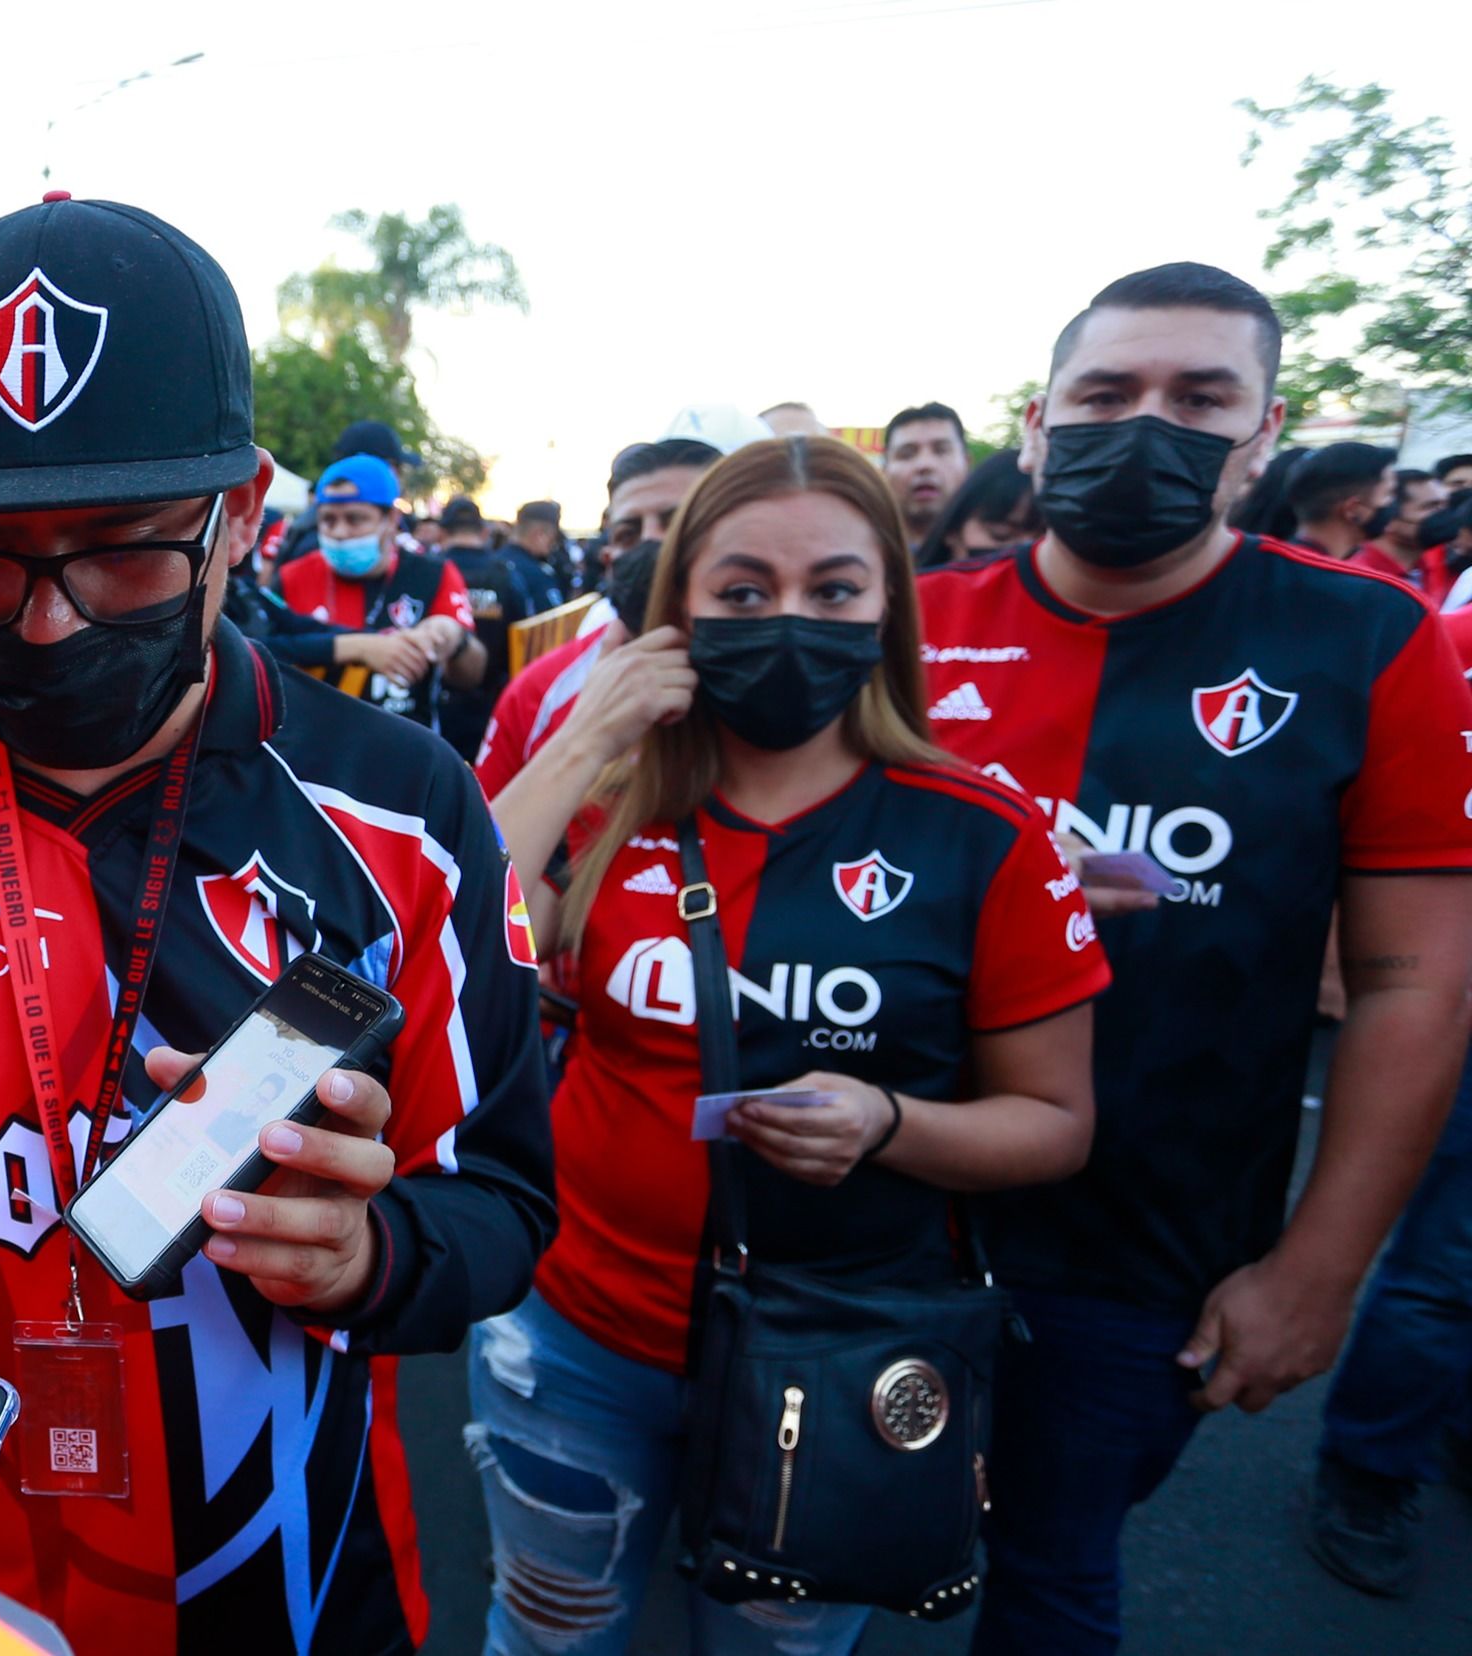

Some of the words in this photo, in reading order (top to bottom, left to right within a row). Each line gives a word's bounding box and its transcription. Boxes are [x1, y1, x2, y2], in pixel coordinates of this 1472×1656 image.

[142, 856, 169, 910] SIGUE
[135, 917, 156, 940] LE
[128, 948, 149, 983] QUE
[23, 994, 44, 1018] LO
[122, 990, 139, 1014] LO
[29, 1024, 53, 1064] QUE
[802, 1027, 878, 1051] .COM
[38, 1069, 56, 1092] LE
[45, 1097, 66, 1152] SIGUE
